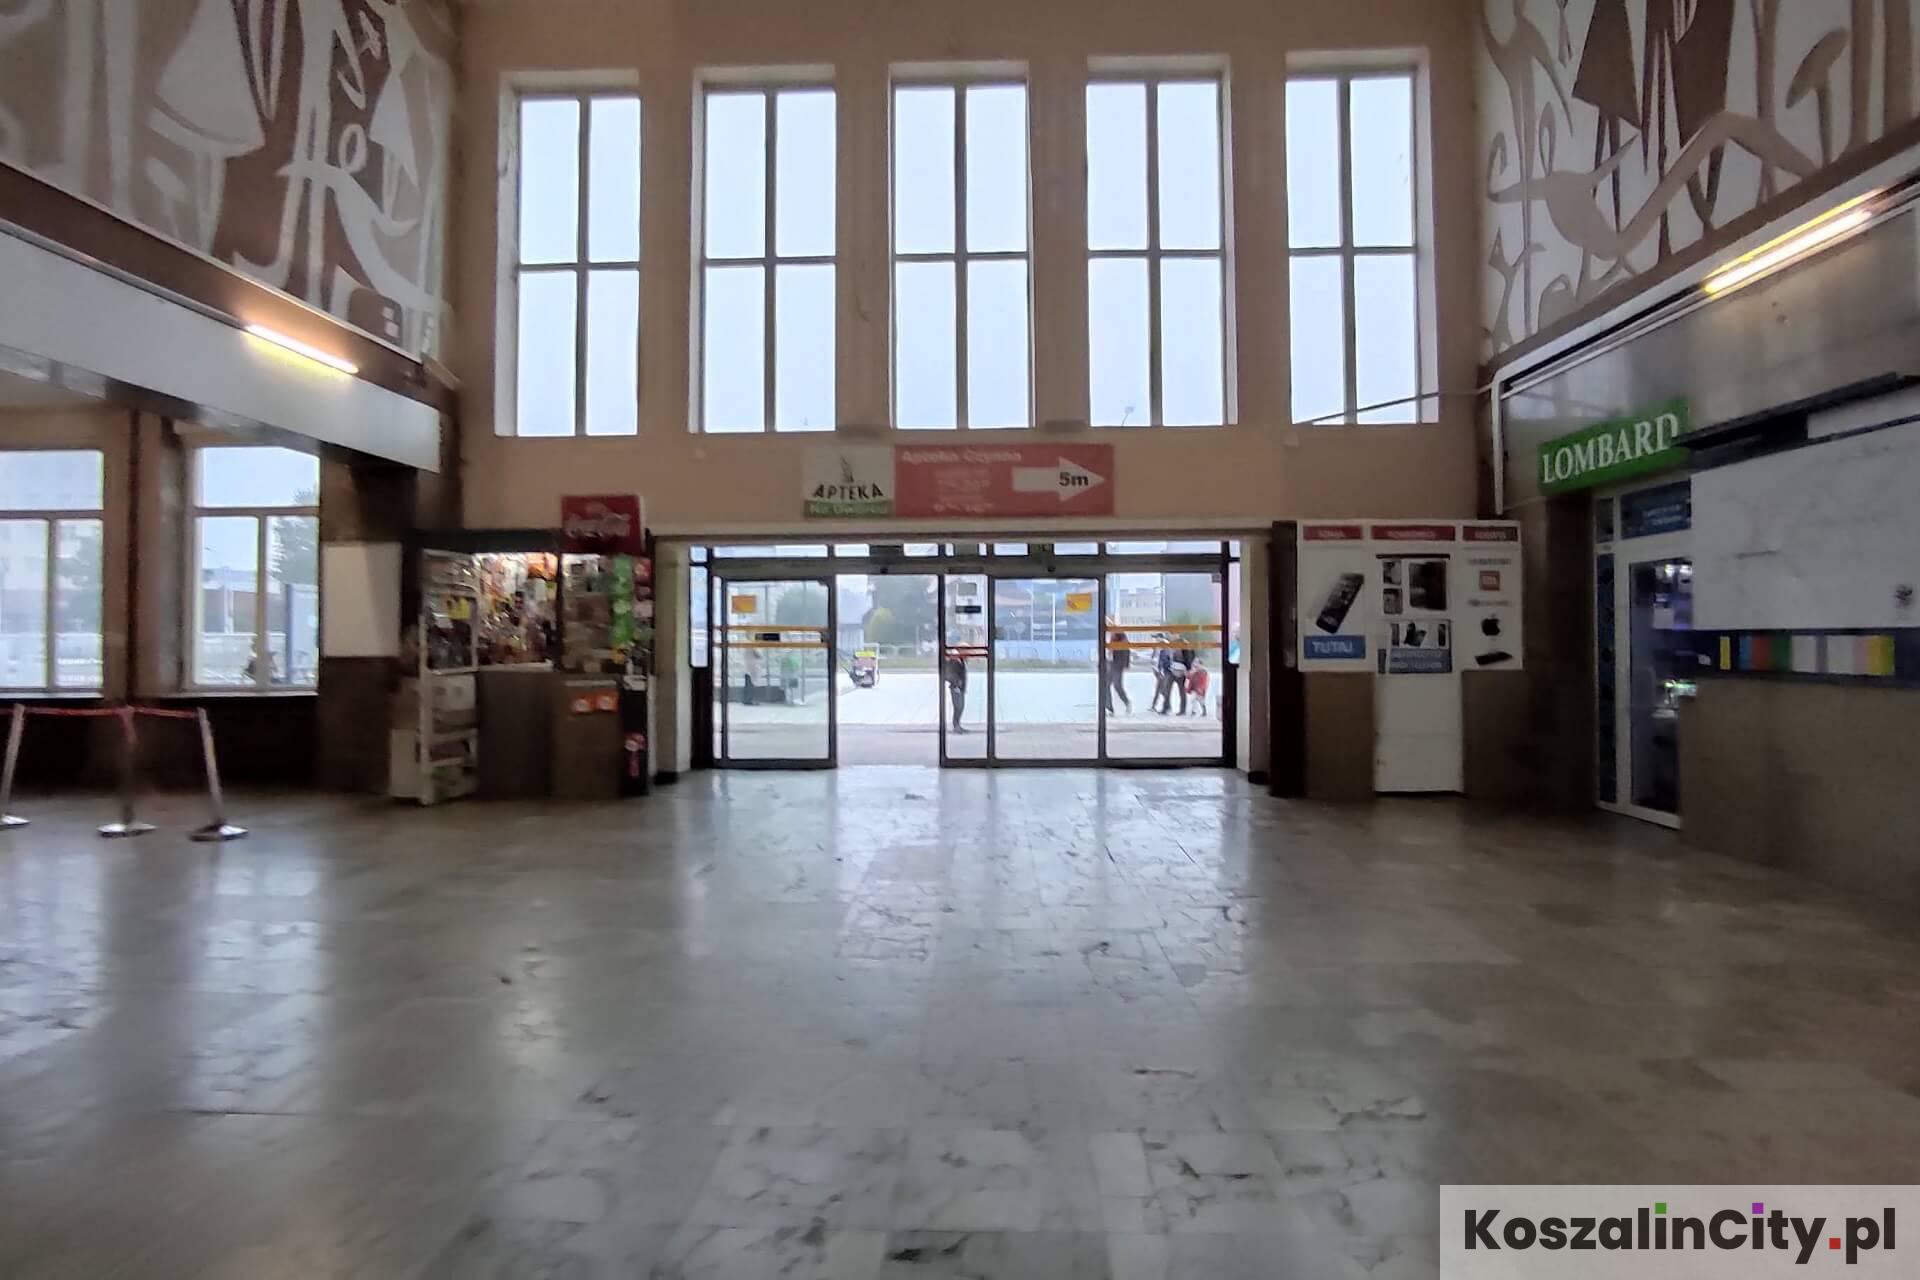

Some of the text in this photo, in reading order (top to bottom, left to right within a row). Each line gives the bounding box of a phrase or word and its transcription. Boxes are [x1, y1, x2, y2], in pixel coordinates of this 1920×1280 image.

[1543, 414, 1679, 483] LOMBARD
[1058, 472, 1089, 486] 5m
[813, 483, 883, 499] APTEKA
